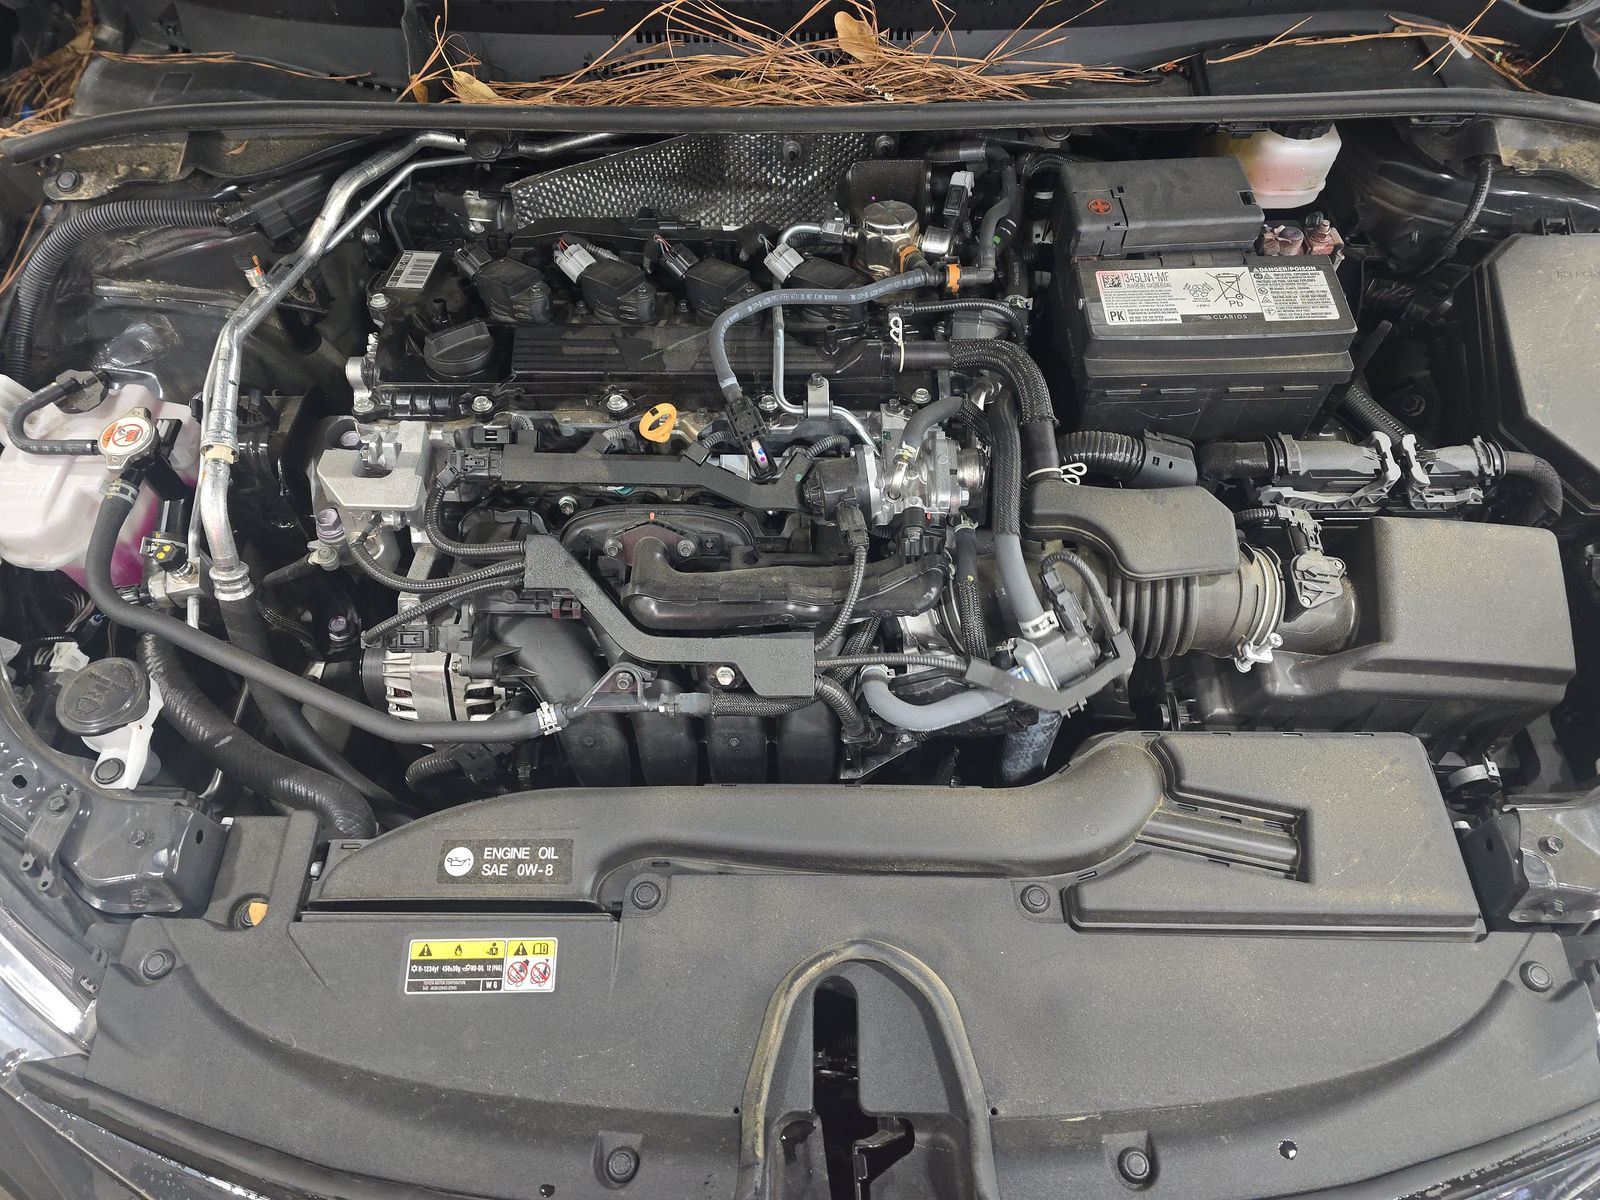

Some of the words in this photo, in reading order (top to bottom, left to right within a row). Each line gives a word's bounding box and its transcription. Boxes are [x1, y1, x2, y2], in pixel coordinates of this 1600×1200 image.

[1123, 271, 1170, 283] 345LN1-MF
[1109, 310, 1125, 321] PK
[483, 847, 531, 859] ENGINE
[538, 846, 559, 860] OIL
[481, 863, 509, 876] SAE
[516, 863, 554, 876] 0W-8
[485, 981, 492, 989] W
[493, 981, 498, 989] 6
